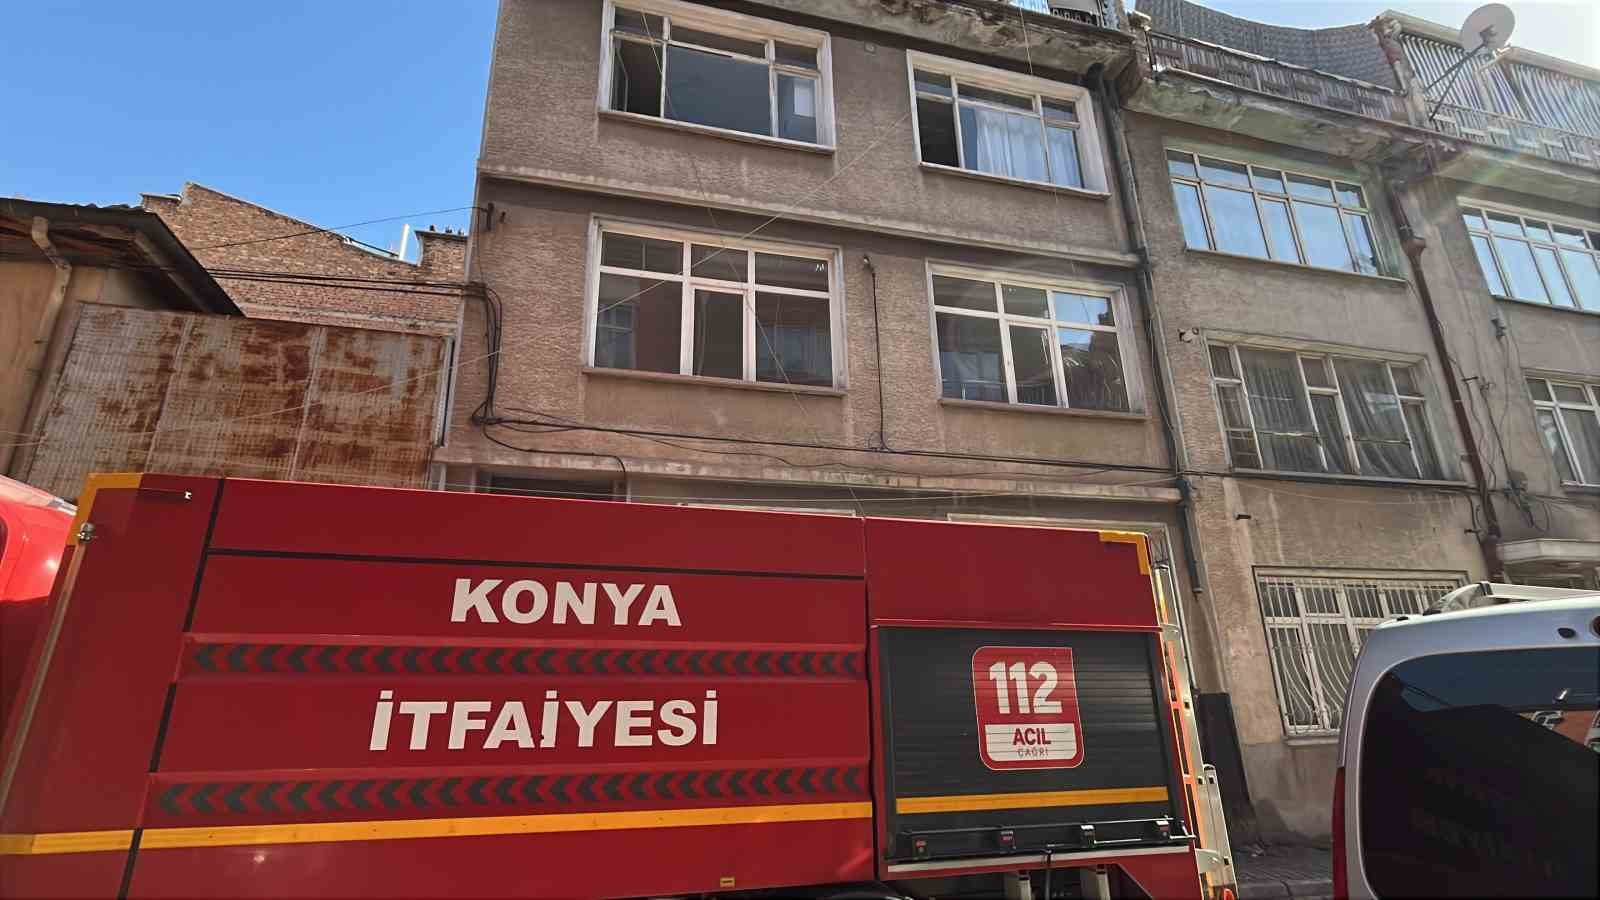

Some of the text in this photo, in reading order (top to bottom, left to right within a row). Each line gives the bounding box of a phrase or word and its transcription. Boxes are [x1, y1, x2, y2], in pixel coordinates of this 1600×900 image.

[450, 578, 682, 627] KONYA
[989, 661, 1063, 714] 112
[369, 689, 719, 751] İTFAİYESİ
